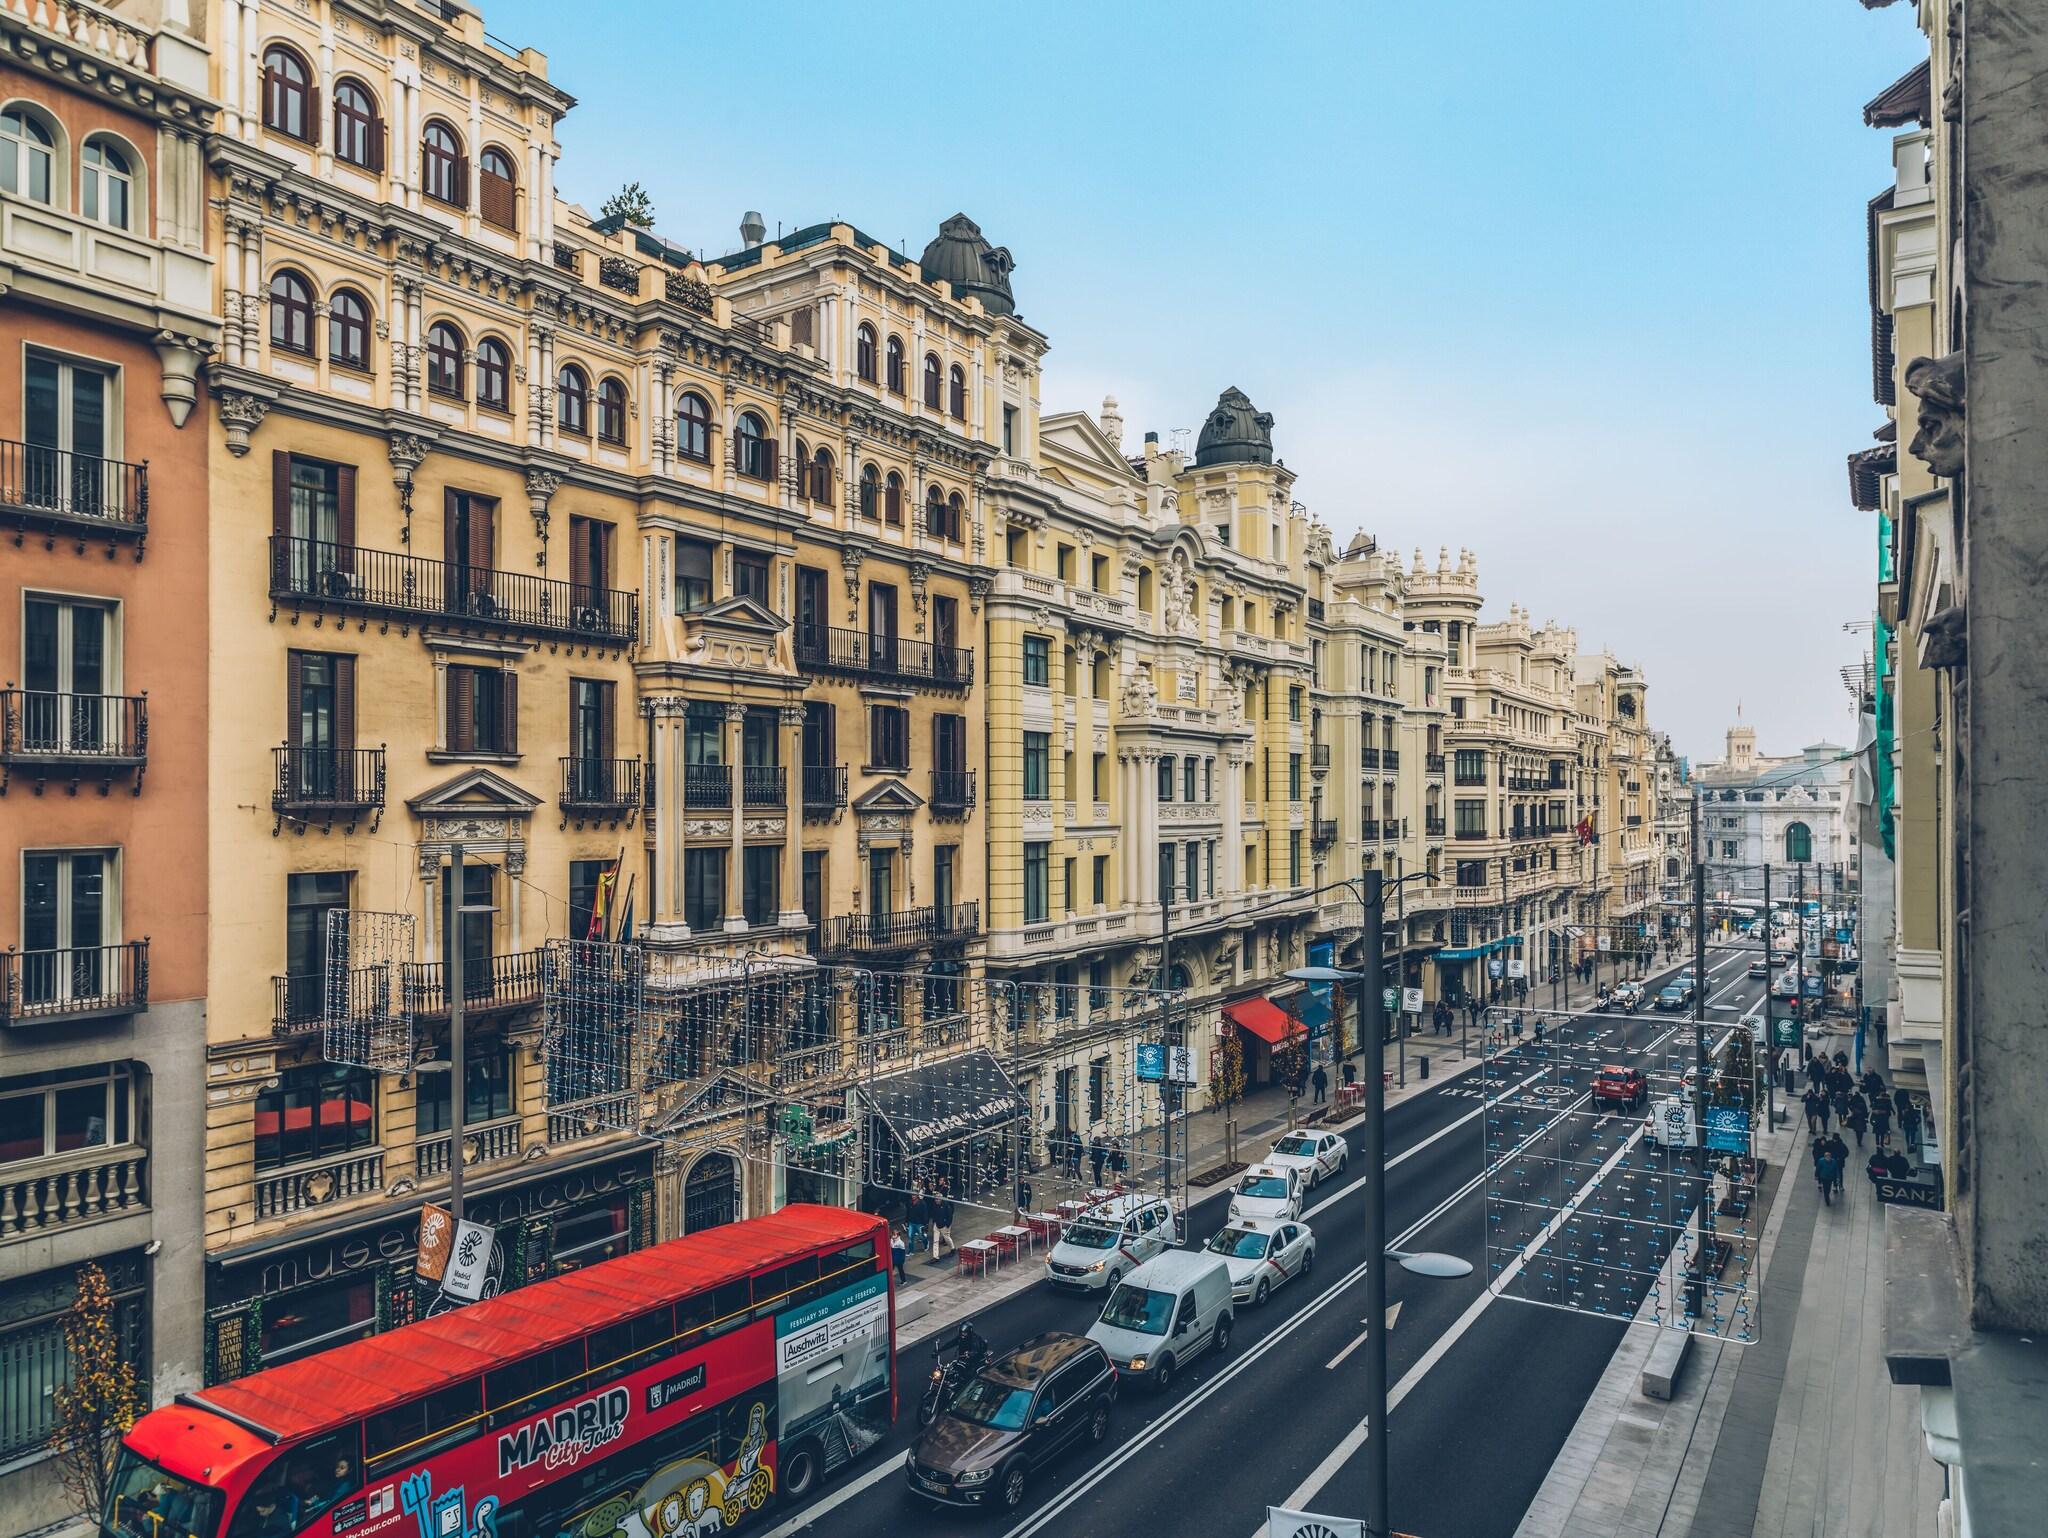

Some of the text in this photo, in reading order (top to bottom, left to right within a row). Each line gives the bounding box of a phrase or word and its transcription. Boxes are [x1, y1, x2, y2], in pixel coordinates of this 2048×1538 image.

[262, 1230, 420, 1296] muse
[454, 1269, 472, 1281] Madrid
[451, 1279, 470, 1290] Central
[846, 1296, 854, 1304] DE
[855, 1286, 877, 1301] FEBRERO
[790, 1307, 829, 1329] FEBRUARY 3RD
[787, 1332, 826, 1358] Auschwitz
[665, 1366, 704, 1402] ¡MADRID!
[498, 1386, 630, 1478] MADRID
[544, 1420, 625, 1470] City Tour
